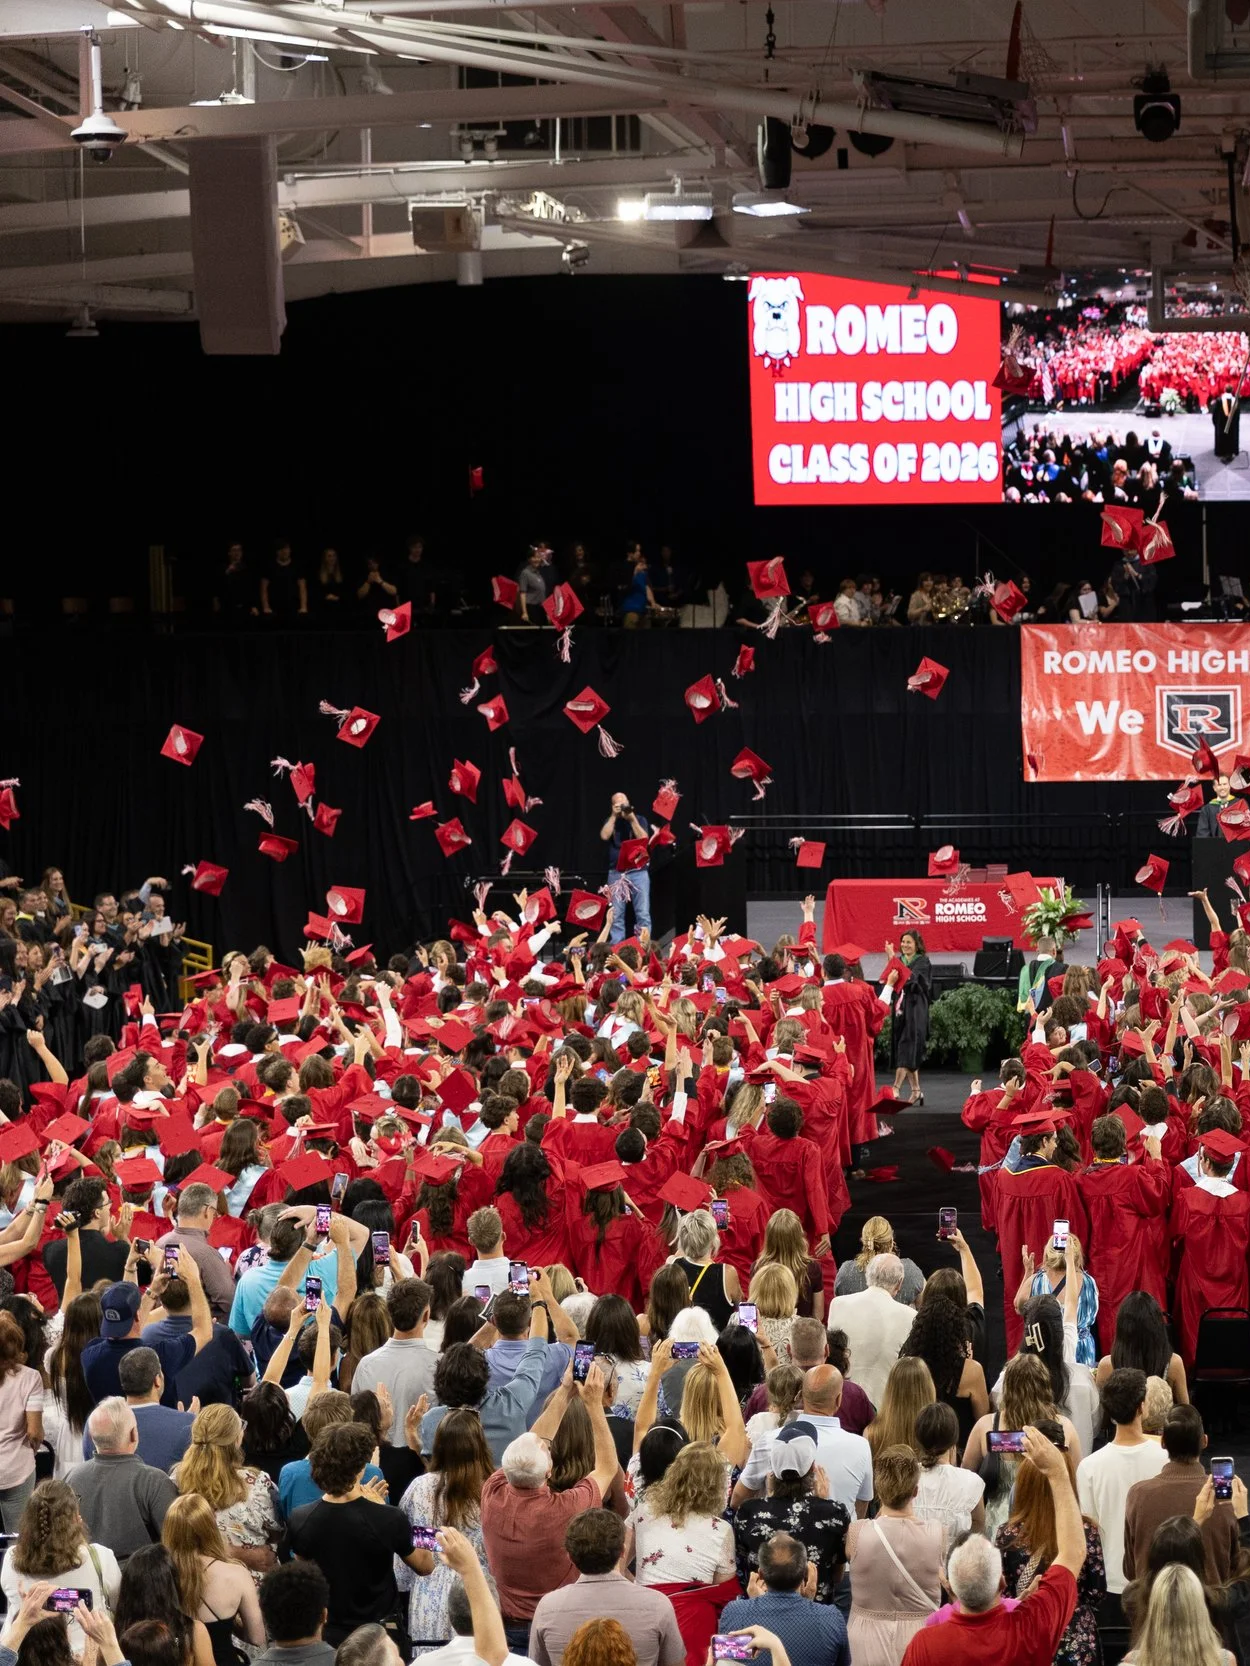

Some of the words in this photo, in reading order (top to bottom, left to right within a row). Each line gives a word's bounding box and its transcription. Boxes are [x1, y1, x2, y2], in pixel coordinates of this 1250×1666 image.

[805, 303, 958, 355] ROMEO
[774, 381, 858, 422] HIGH
[861, 380, 992, 422] SCHOOL
[768, 443, 871, 485] CLASS
[872, 442, 918, 484] OF
[920, 441, 999, 483] 2026
[1043, 649, 1157, 674] ROMEO
[1167, 648, 1249, 673] HIGH
[1074, 700, 1145, 735] We
[1170, 704, 1228, 734] R
[935, 902, 986, 915] ROMEO
[935, 915, 955, 923] HIGH
[956, 914, 987, 923] SCHOOL
